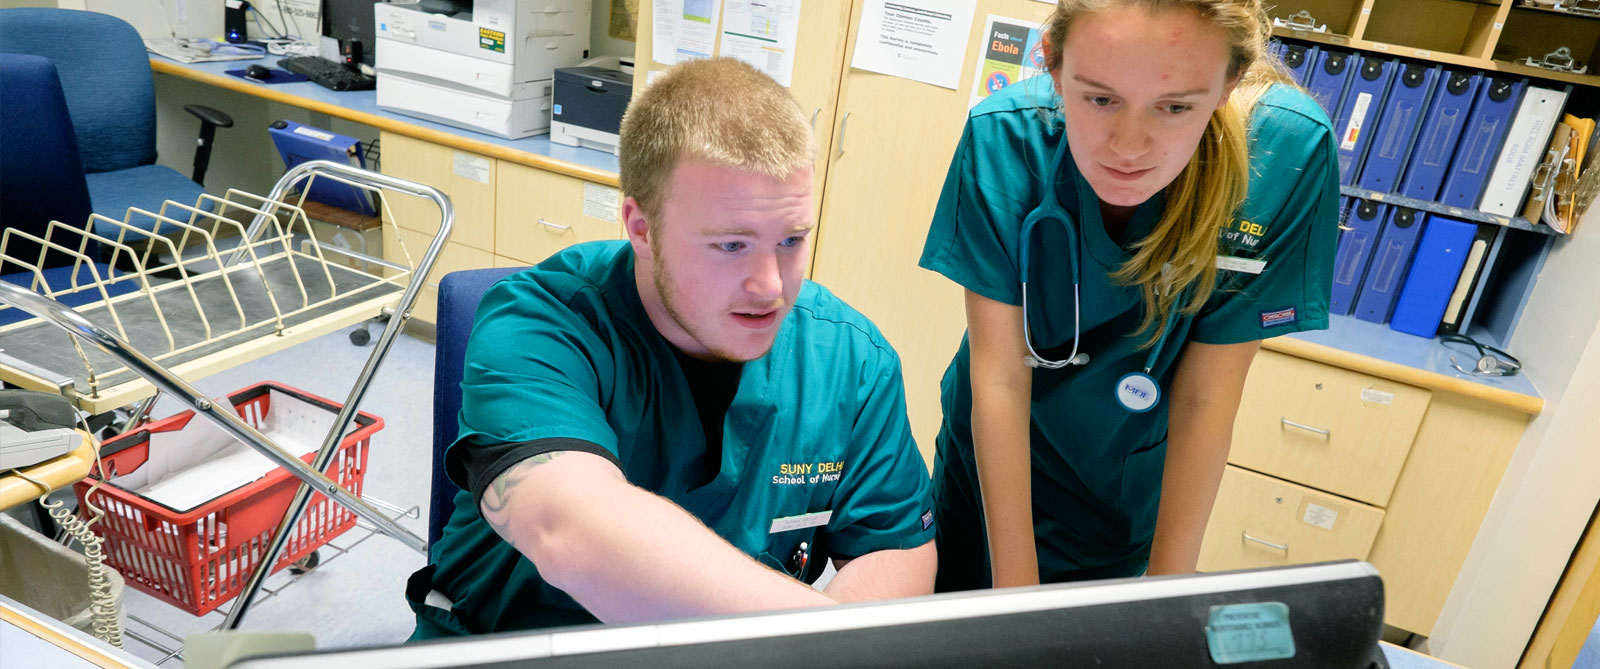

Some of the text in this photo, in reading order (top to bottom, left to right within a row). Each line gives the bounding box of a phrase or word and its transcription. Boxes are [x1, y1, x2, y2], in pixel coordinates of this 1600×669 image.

[994, 31, 1010, 40] Facts
[992, 40, 1019, 55] Ebola
[1226, 232, 1240, 241] of
[780, 464, 813, 474] SUNY
[772, 475, 806, 485] School
[809, 474, 820, 484] of
